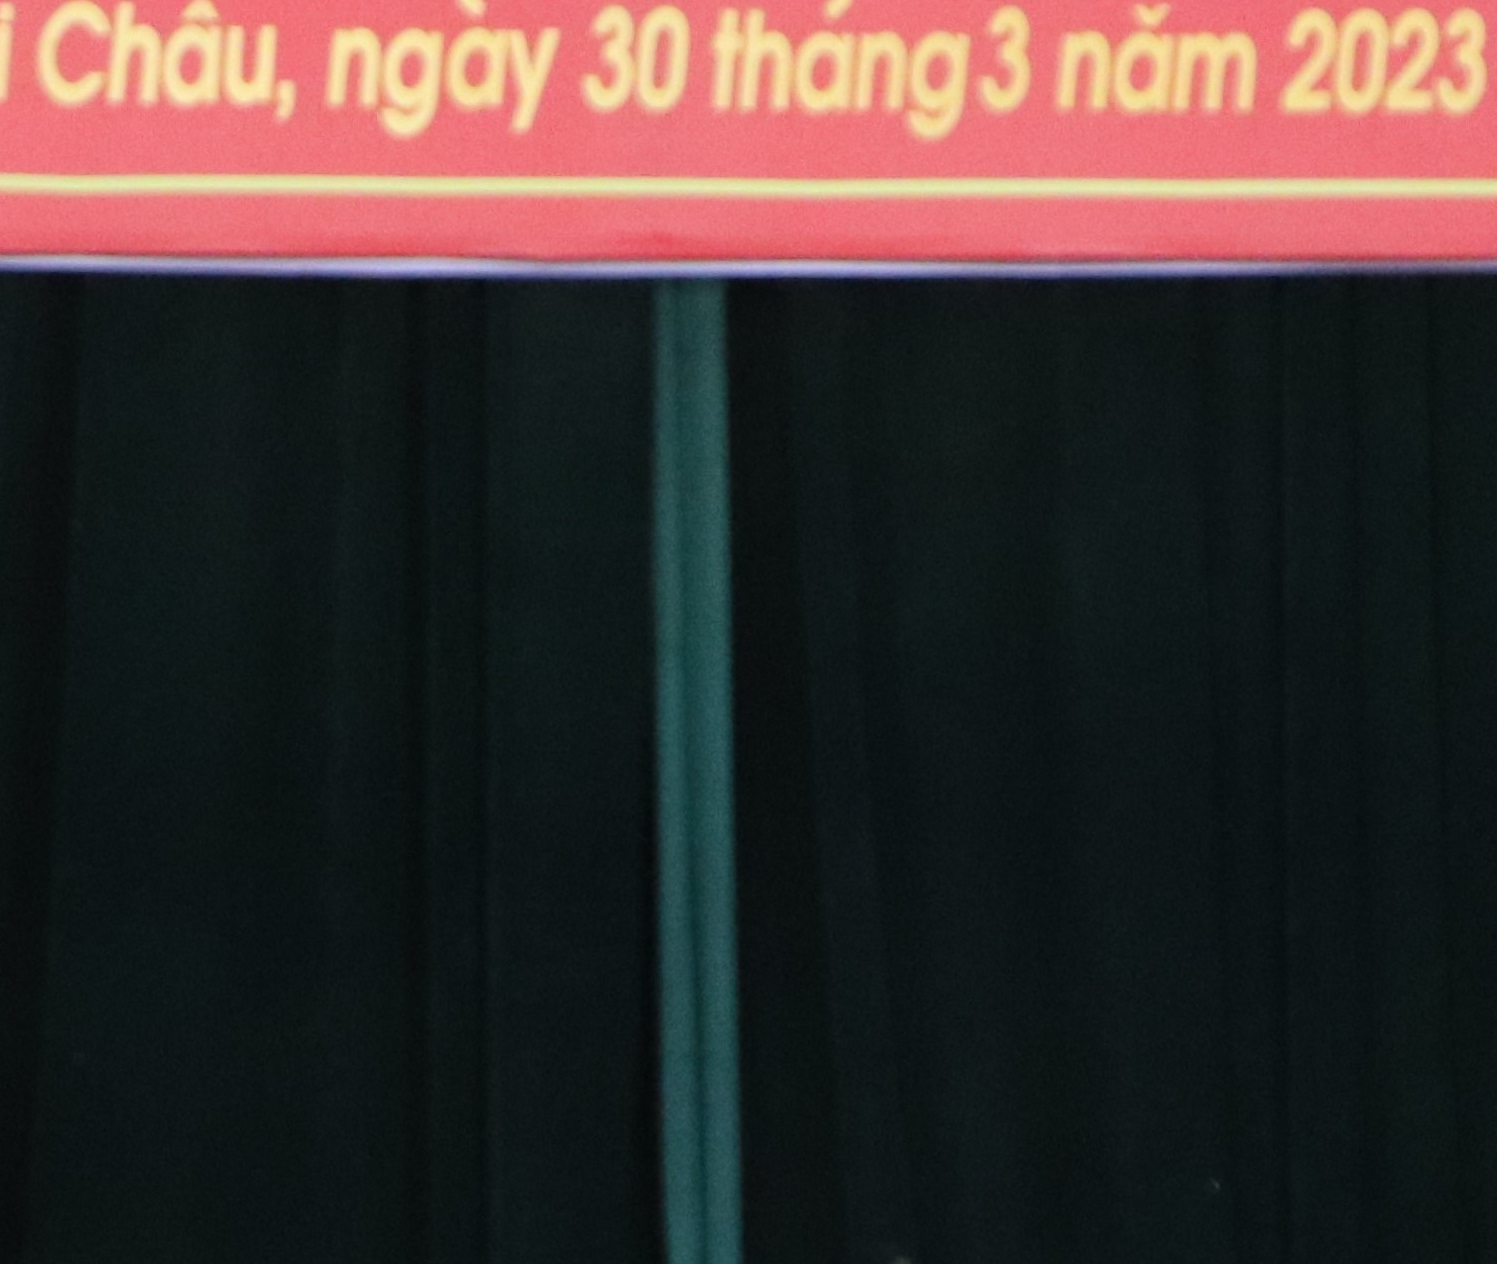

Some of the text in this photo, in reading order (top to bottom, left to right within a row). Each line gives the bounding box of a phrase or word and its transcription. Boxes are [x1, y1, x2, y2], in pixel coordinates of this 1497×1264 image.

[37, 0, 296, 122] Châu,
[326, 0, 561, 138] ngày
[582, 4, 691, 111] 30
[711, 0, 971, 138] tháng
[977, 4, 1032, 113] 3
[1057, 3, 1258, 114] năm
[1283, 7, 1488, 115] 2023
